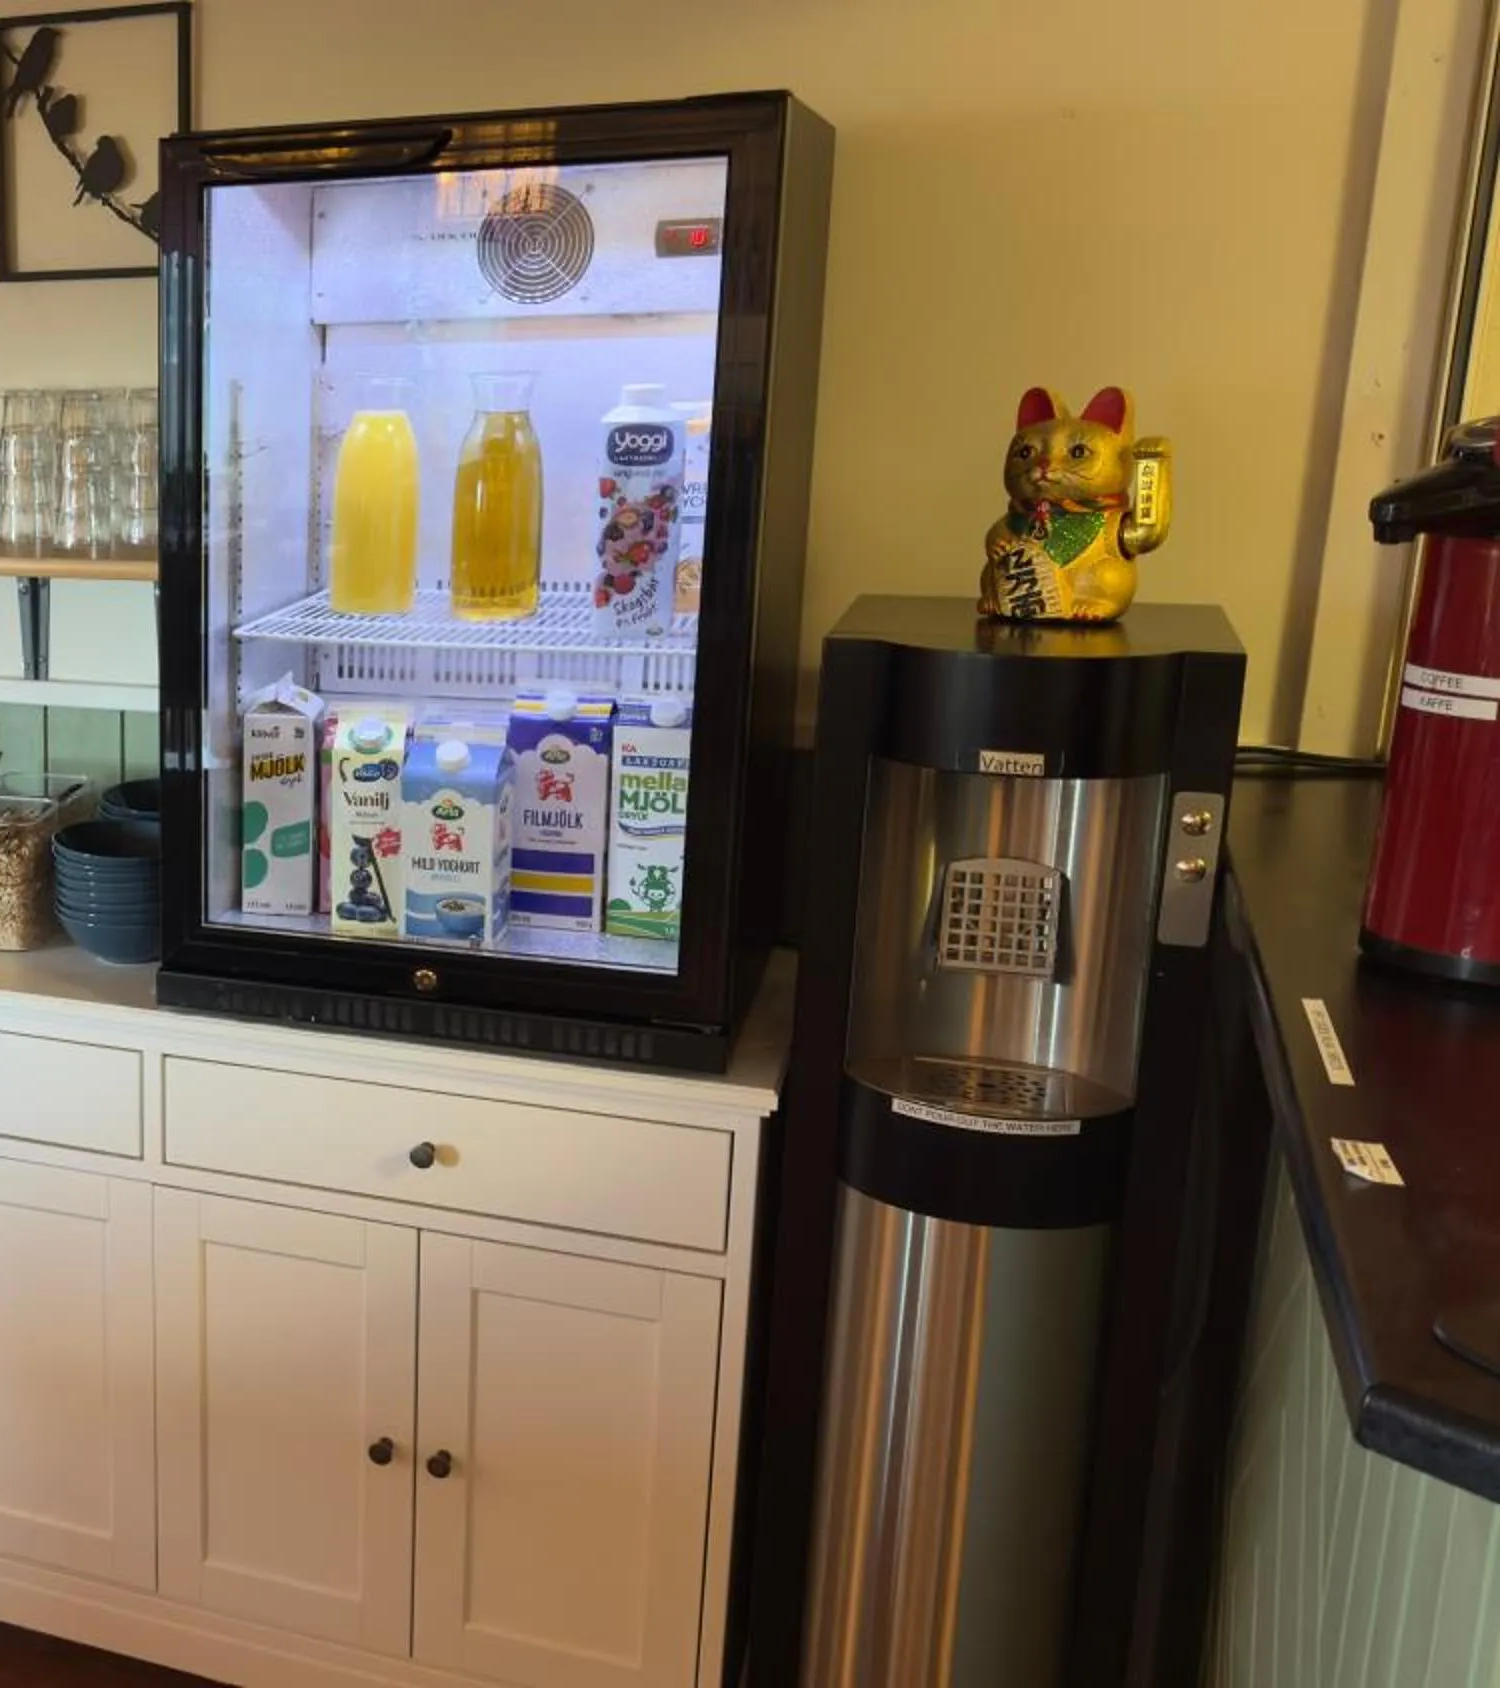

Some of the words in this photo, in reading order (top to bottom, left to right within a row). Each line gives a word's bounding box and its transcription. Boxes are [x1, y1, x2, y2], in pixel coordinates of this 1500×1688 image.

[1420, 671, 1462, 689] COFFEE
[250, 753, 305, 782] MJÖLK
[981, 755, 1043, 773] Vatten
[344, 791, 390, 810] Vanilj
[523, 809, 584, 829] FILMJÖLK
[411, 856, 435, 870] MILD
[438, 859, 481, 874] YOGHURT
[1005, 1121, 1044, 1132] WATER
